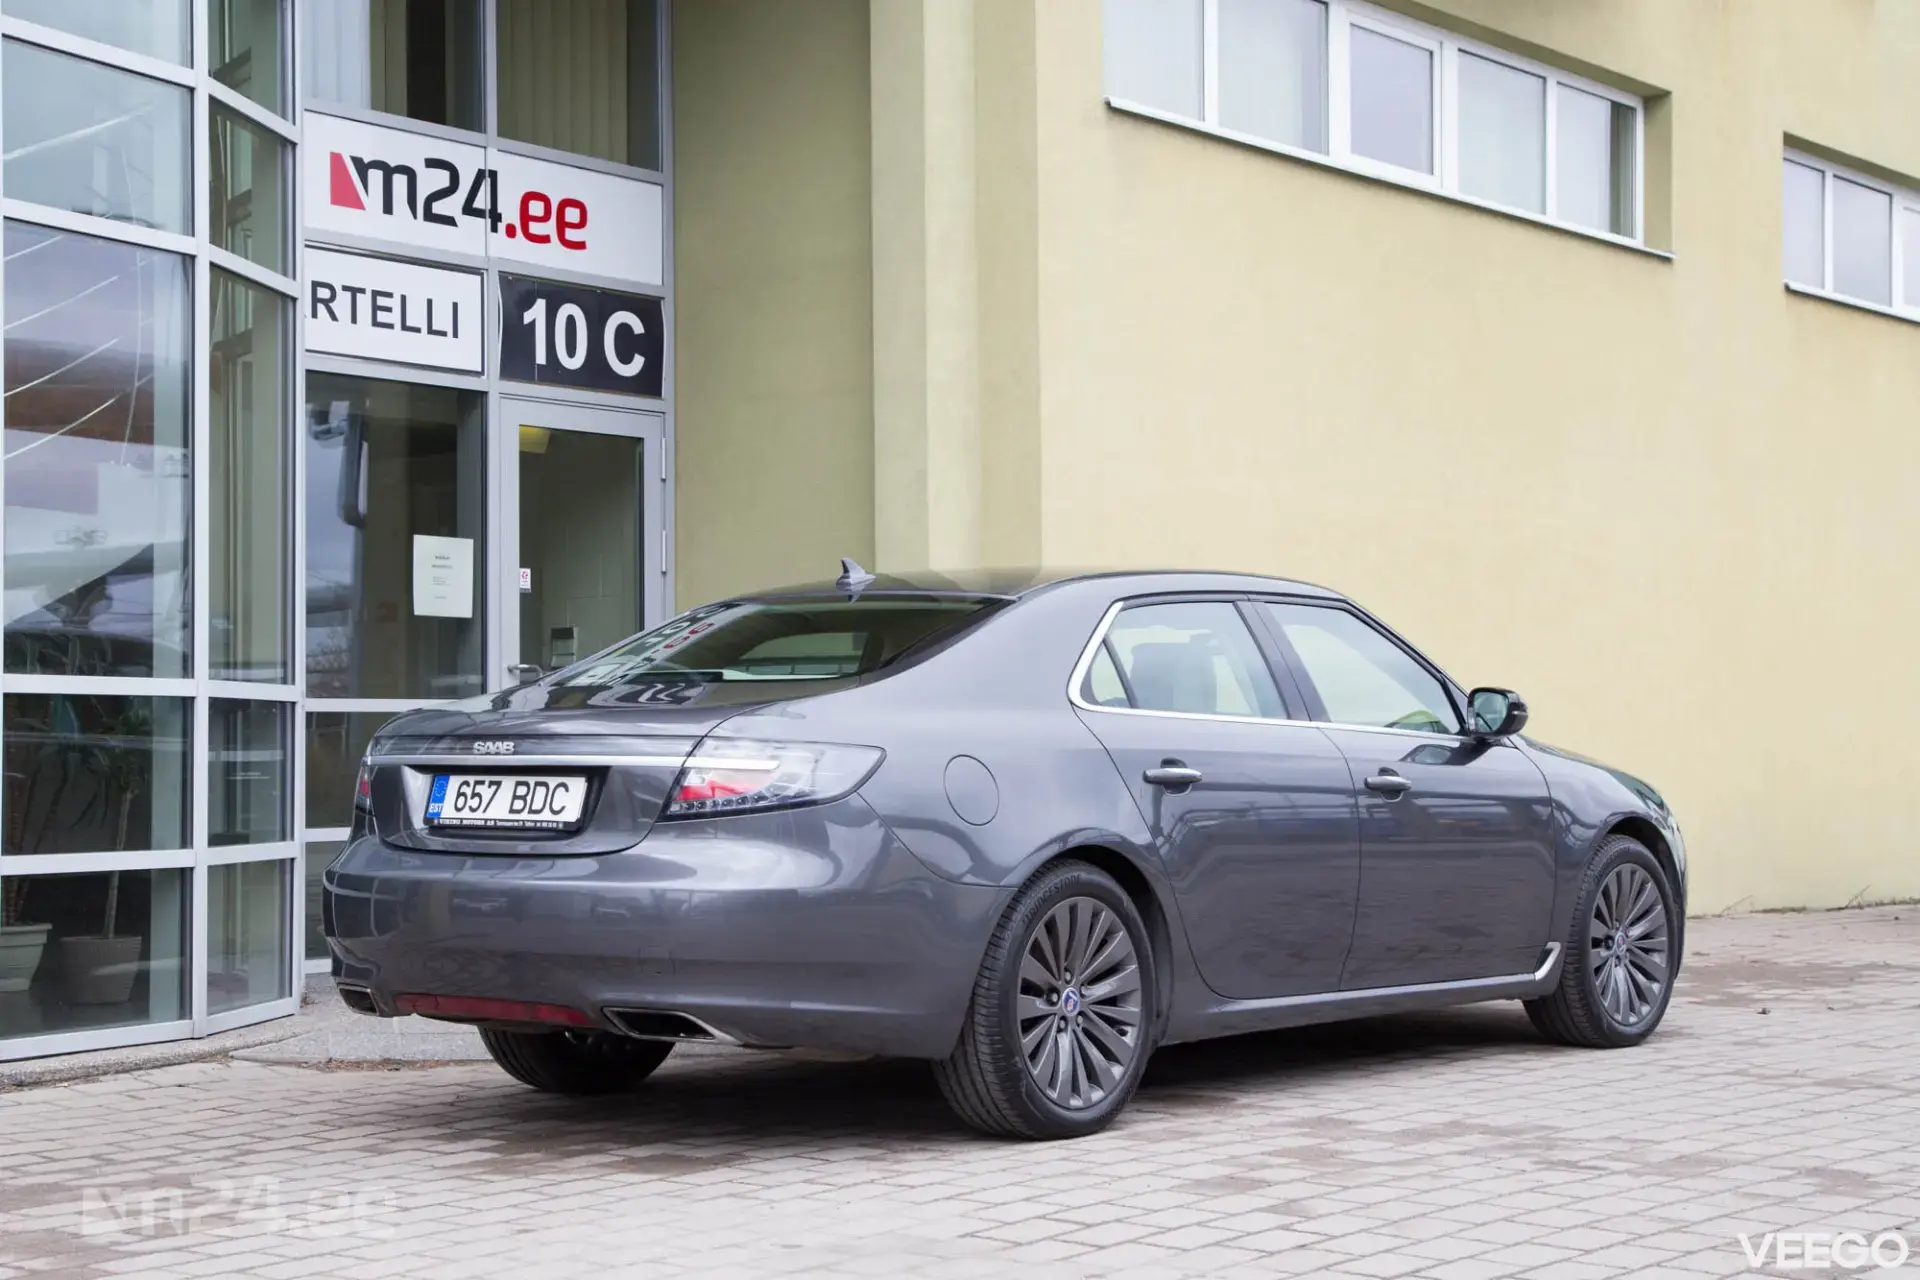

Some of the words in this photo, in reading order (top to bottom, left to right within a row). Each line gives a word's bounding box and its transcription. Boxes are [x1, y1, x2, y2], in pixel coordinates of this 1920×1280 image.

[350, 154, 588, 251] m24.ee
[304, 279, 459, 339] RTELLI
[523, 298, 588, 371] 10
[603, 310, 646, 378] C
[473, 741, 515, 754] SAAB
[429, 802, 444, 813] EST
[454, 780, 502, 814] 657
[508, 780, 570, 816] BDC
